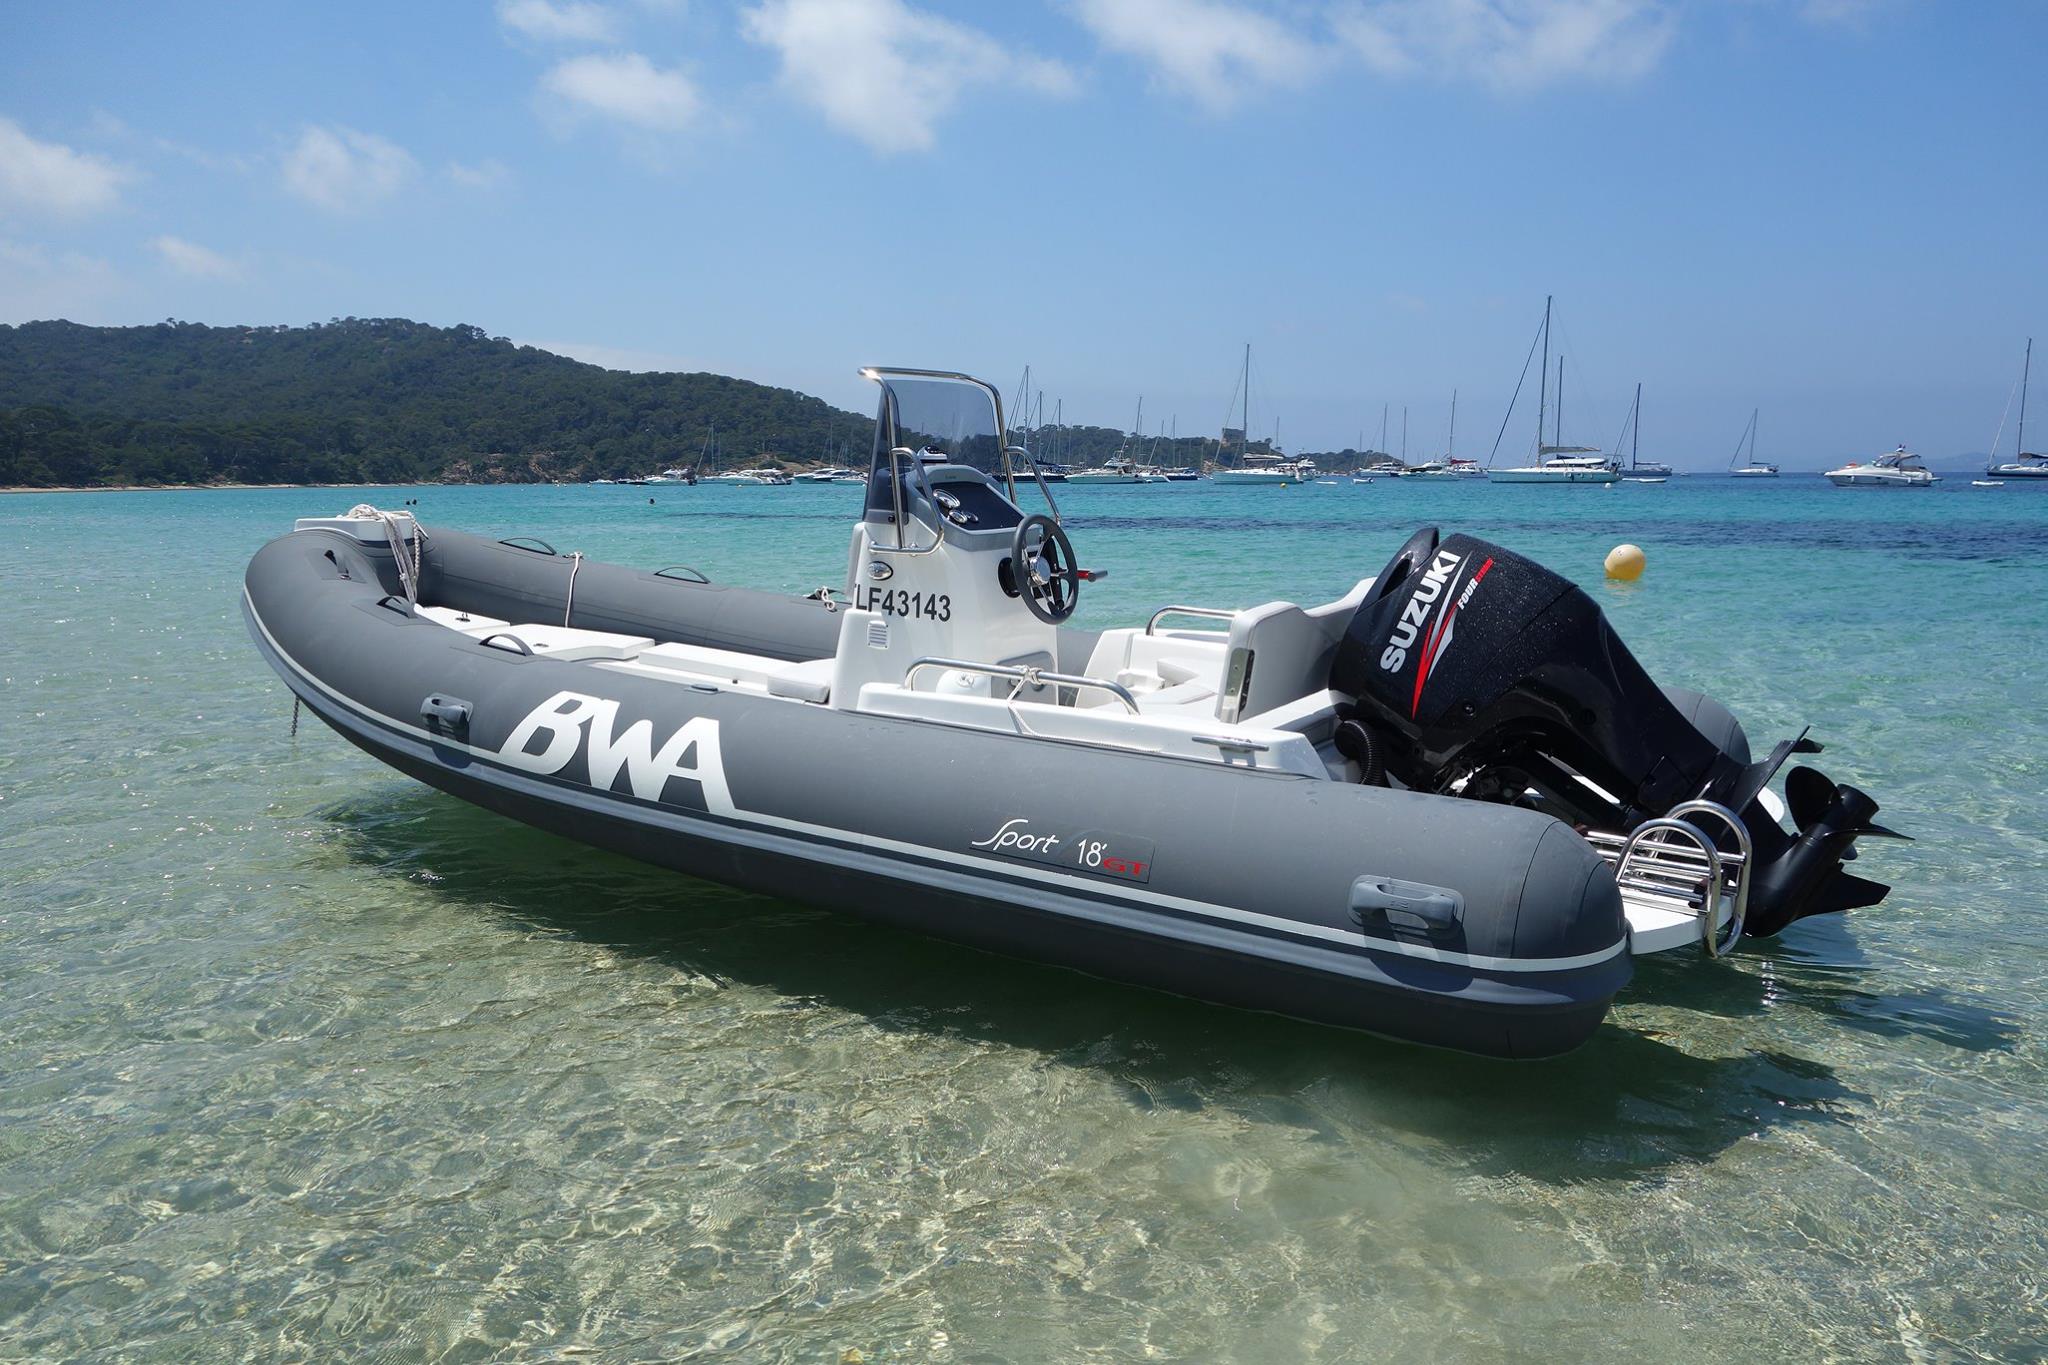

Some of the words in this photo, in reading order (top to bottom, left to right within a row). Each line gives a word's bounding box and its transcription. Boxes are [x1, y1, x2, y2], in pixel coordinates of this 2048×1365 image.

[854, 583, 951, 622] LF43143
[1380, 550, 1461, 673] SUZUKI
[1457, 577, 1478, 610] FOUR
[498, 690, 736, 815] BWA
[971, 818, 1060, 854] Sport
[1103, 856, 1149, 876] GT
